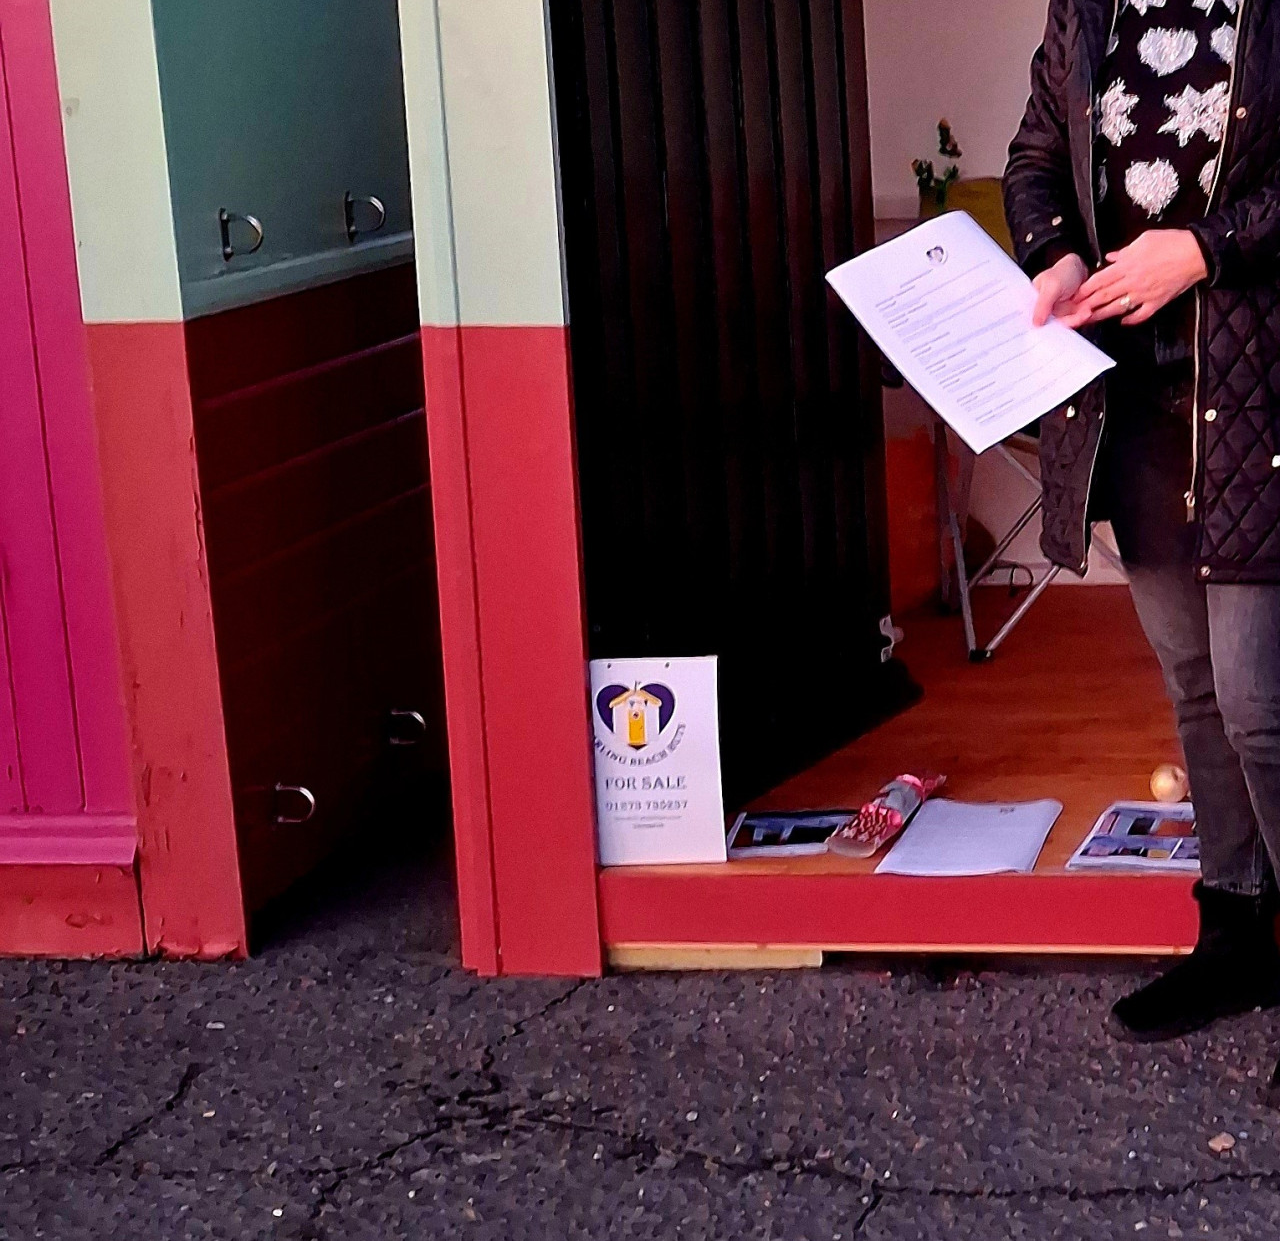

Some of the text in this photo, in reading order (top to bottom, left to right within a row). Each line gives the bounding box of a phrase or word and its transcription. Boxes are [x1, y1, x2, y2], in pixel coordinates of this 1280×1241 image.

[629, 748, 669, 766] BEACH
[605, 774, 688, 791] FOR SALE
